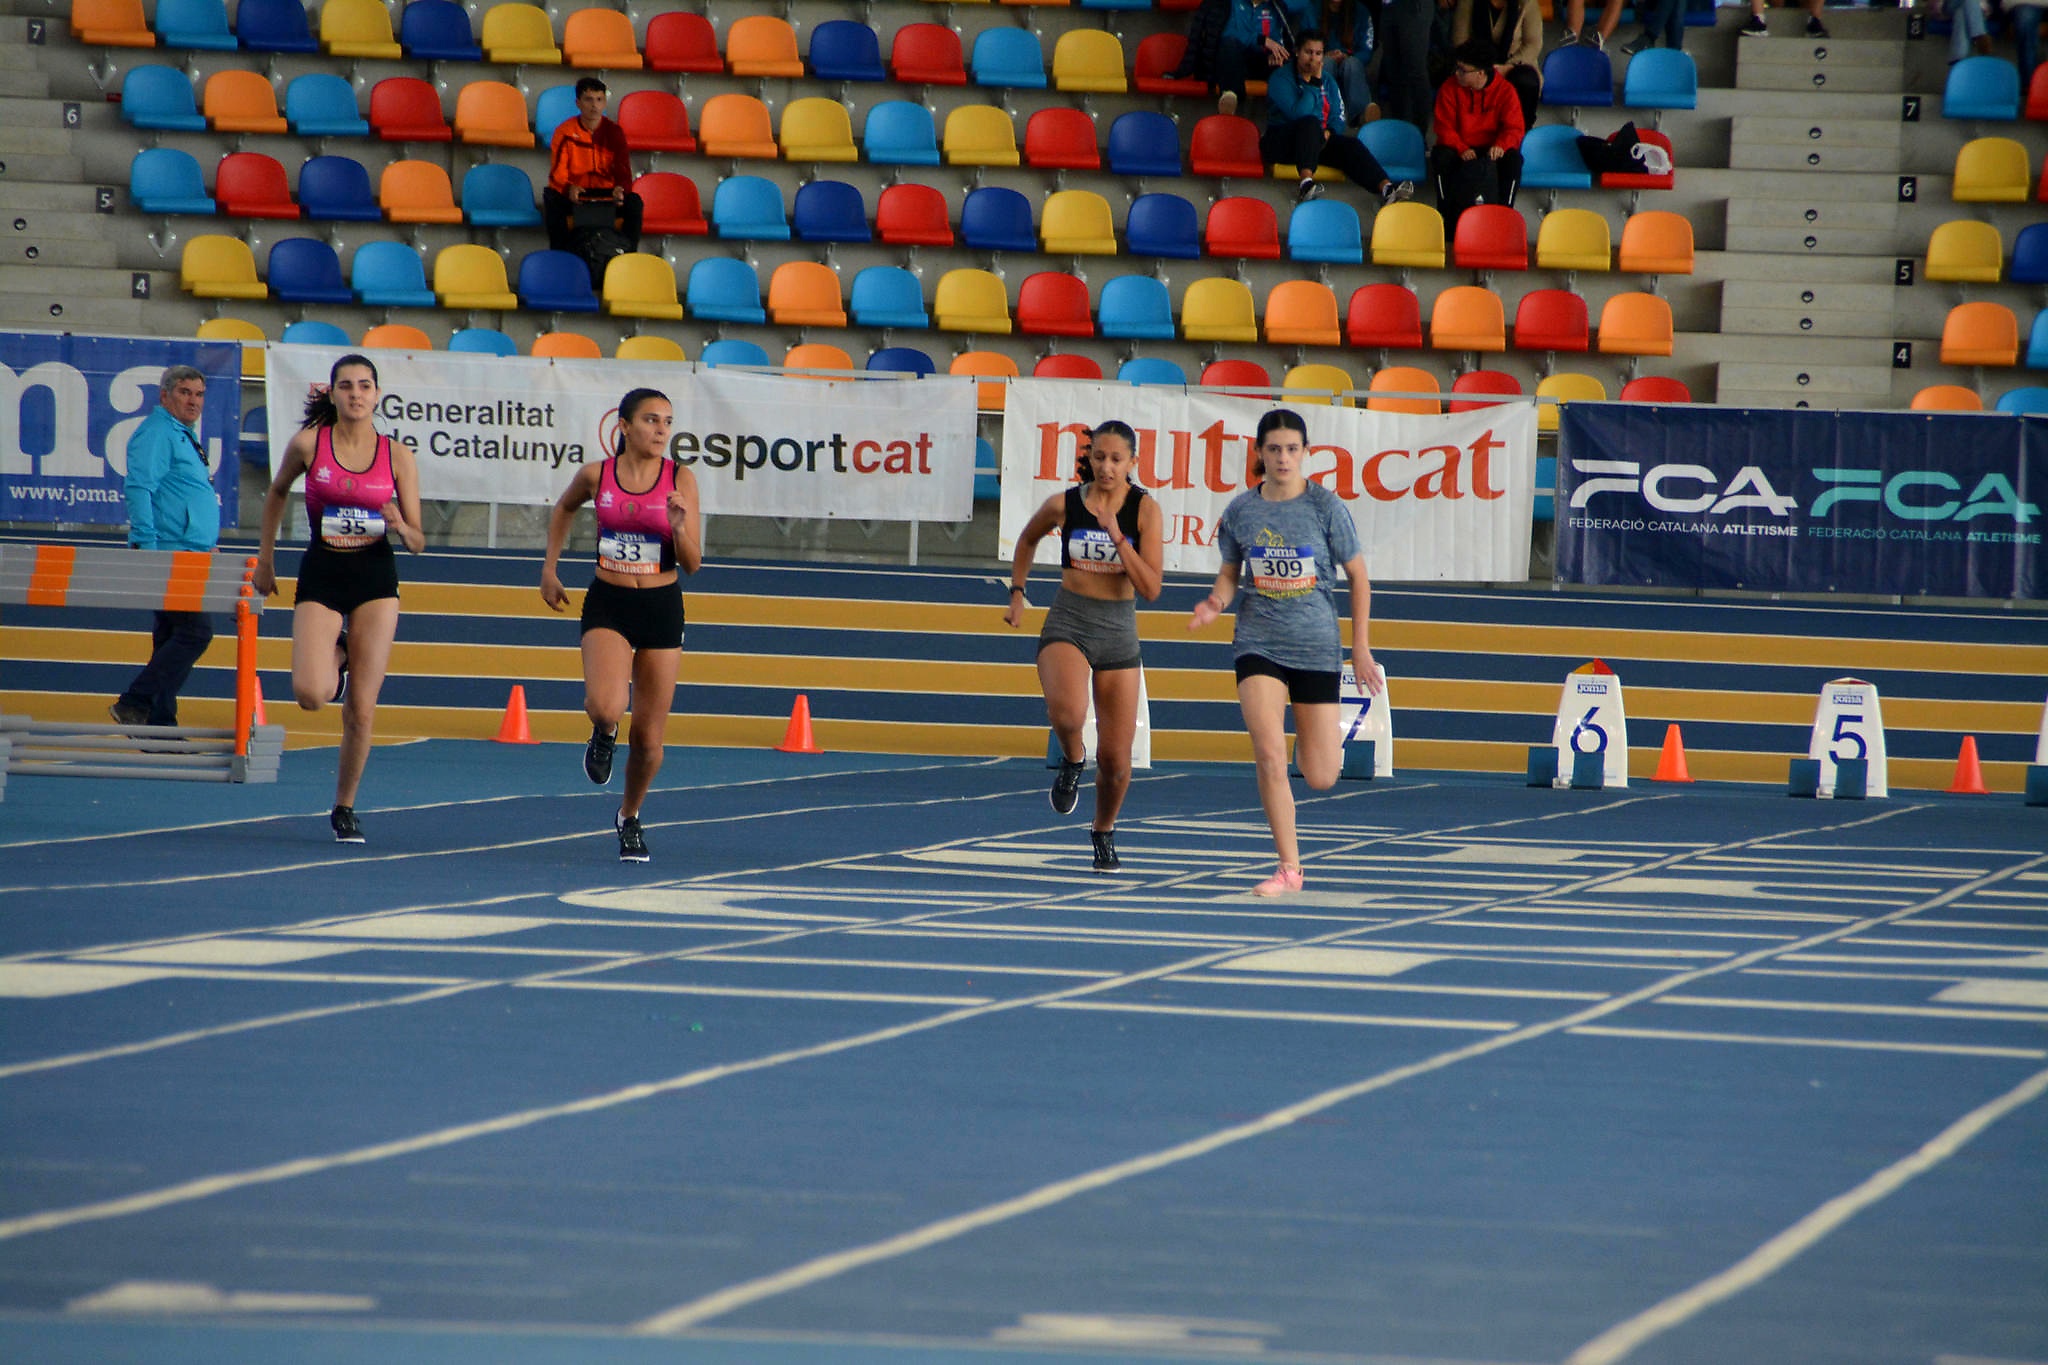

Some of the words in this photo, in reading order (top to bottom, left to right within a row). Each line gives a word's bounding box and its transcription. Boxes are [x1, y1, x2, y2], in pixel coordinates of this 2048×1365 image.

[32, 24, 42, 39] 7
[67, 108, 78, 124] 6
[1906, 103, 1916, 117] 7
[1902, 183, 1913, 197] 6
[100, 193, 111, 208] 5
[1900, 265, 1910, 280] 5
[136, 278, 147, 294] 4
[1896, 347, 1907, 362] 4
[381, 393, 555, 428] Generalitat
[430, 430, 585, 469] Catalunya
[670, 431, 933, 482] esportcat
[1569, 459, 1799, 517] FCA
[1809, 467, 2042, 524] FCA
[340, 519, 367, 535] 35
[1569, 517, 1645, 531] FEDERACIÓ
[1648, 520, 1720, 534] CATALANA
[1722, 523, 1799, 537] ATLETISME
[1808, 526, 1887, 540] FEDERACIÓ
[1889, 529, 1961, 541] CATALANA
[1965, 531, 2041, 544] ATLETISME
[614, 543, 641, 562] 33
[1081, 542, 1117, 562] 157
[1261, 560, 1303, 578] 309
[1341, 697, 1371, 749] 7
[1570, 706, 1608, 753] 6
[1828, 714, 1867, 766] 5
